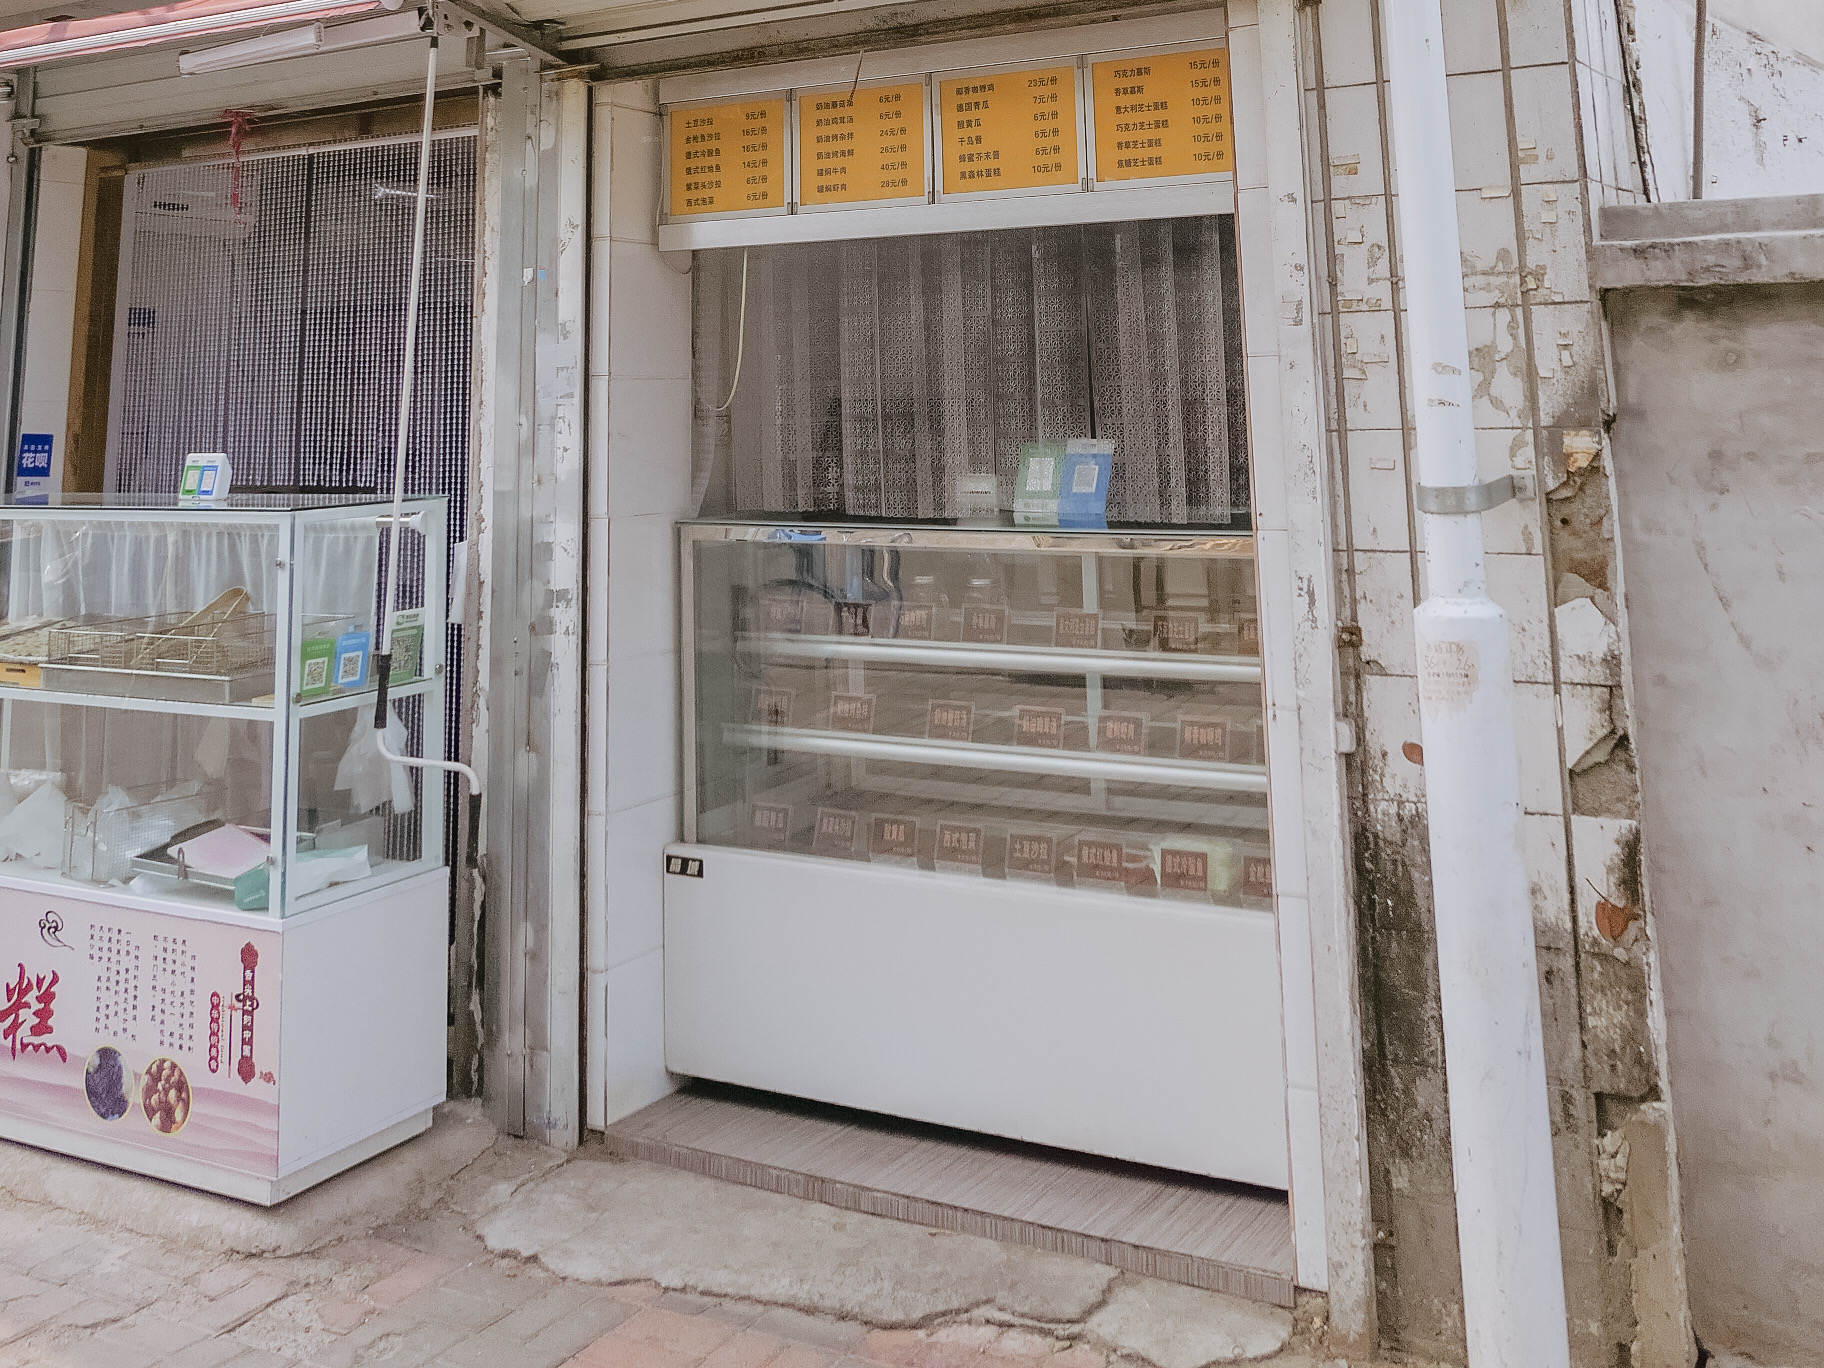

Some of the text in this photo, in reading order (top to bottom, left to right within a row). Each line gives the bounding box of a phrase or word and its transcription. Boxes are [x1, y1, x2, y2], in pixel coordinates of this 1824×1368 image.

[1114, 58, 1220, 79] 巧克力慕斯 15元/份
[1028, 76, 1058, 87] 23元/份
[1114, 76, 1221, 97] 香草慕斯 15元/份
[879, 93, 901, 103] 6元/份
[1033, 93, 1058, 104] 7元/份
[1115, 95, 1221, 114] 意大利芝士蛋糕 10元/份
[685, 118, 713, 128] 土豆沙拉
[1116, 113, 1222, 132] 巧克力芝士蛋糕 10元/份
[958, 136, 982, 146] 千岛酱
[1117, 132, 1223, 150] 香草芝士蛋糕 10元/份
[1193, 150, 1224, 161] 10元/份
[1032, 162, 1062, 173] 10元/份
[22, 452, 48, 468] 花呗
[0, 962, 68, 1064] 糕
